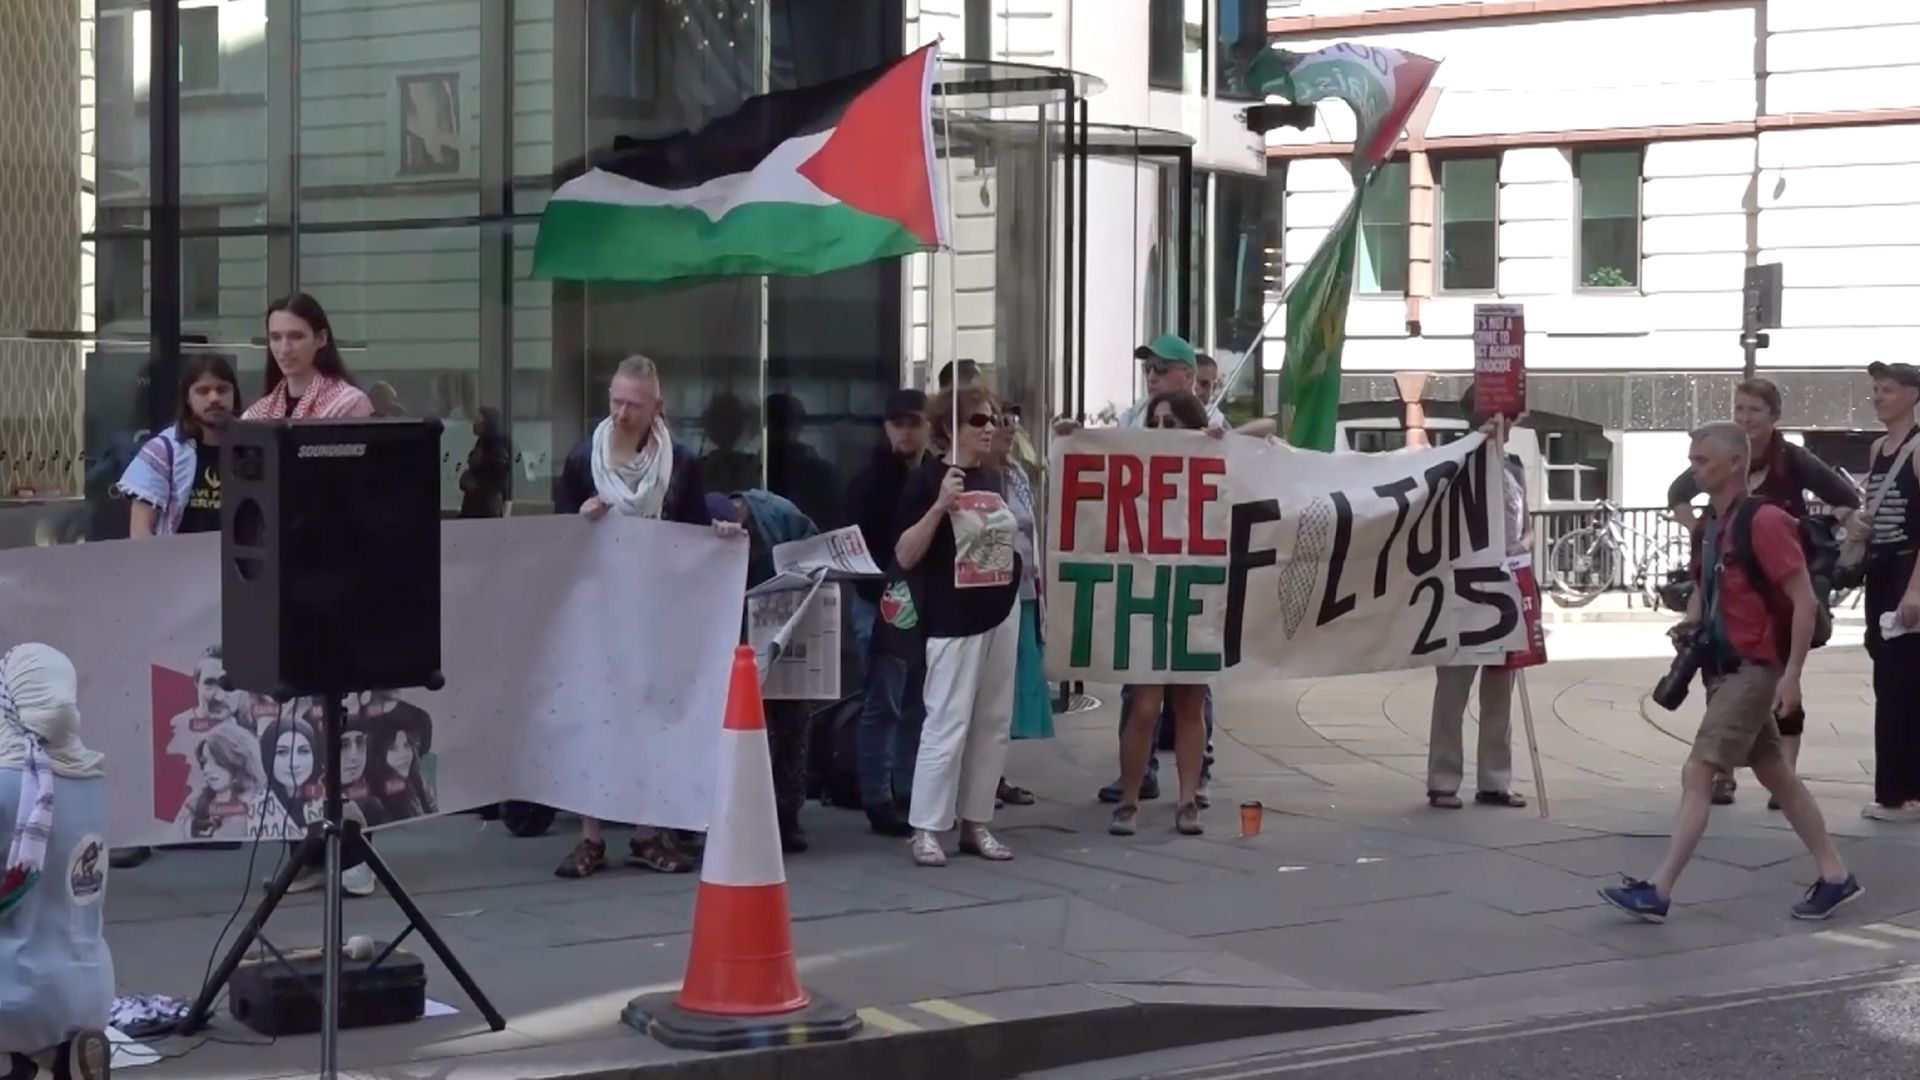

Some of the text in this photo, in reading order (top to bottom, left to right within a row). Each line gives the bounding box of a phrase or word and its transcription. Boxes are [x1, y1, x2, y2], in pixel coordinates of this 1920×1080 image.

[1059, 453, 1227, 556] FREE
[1058, 562, 1226, 671] THE
[1409, 566, 1519, 656] 25
